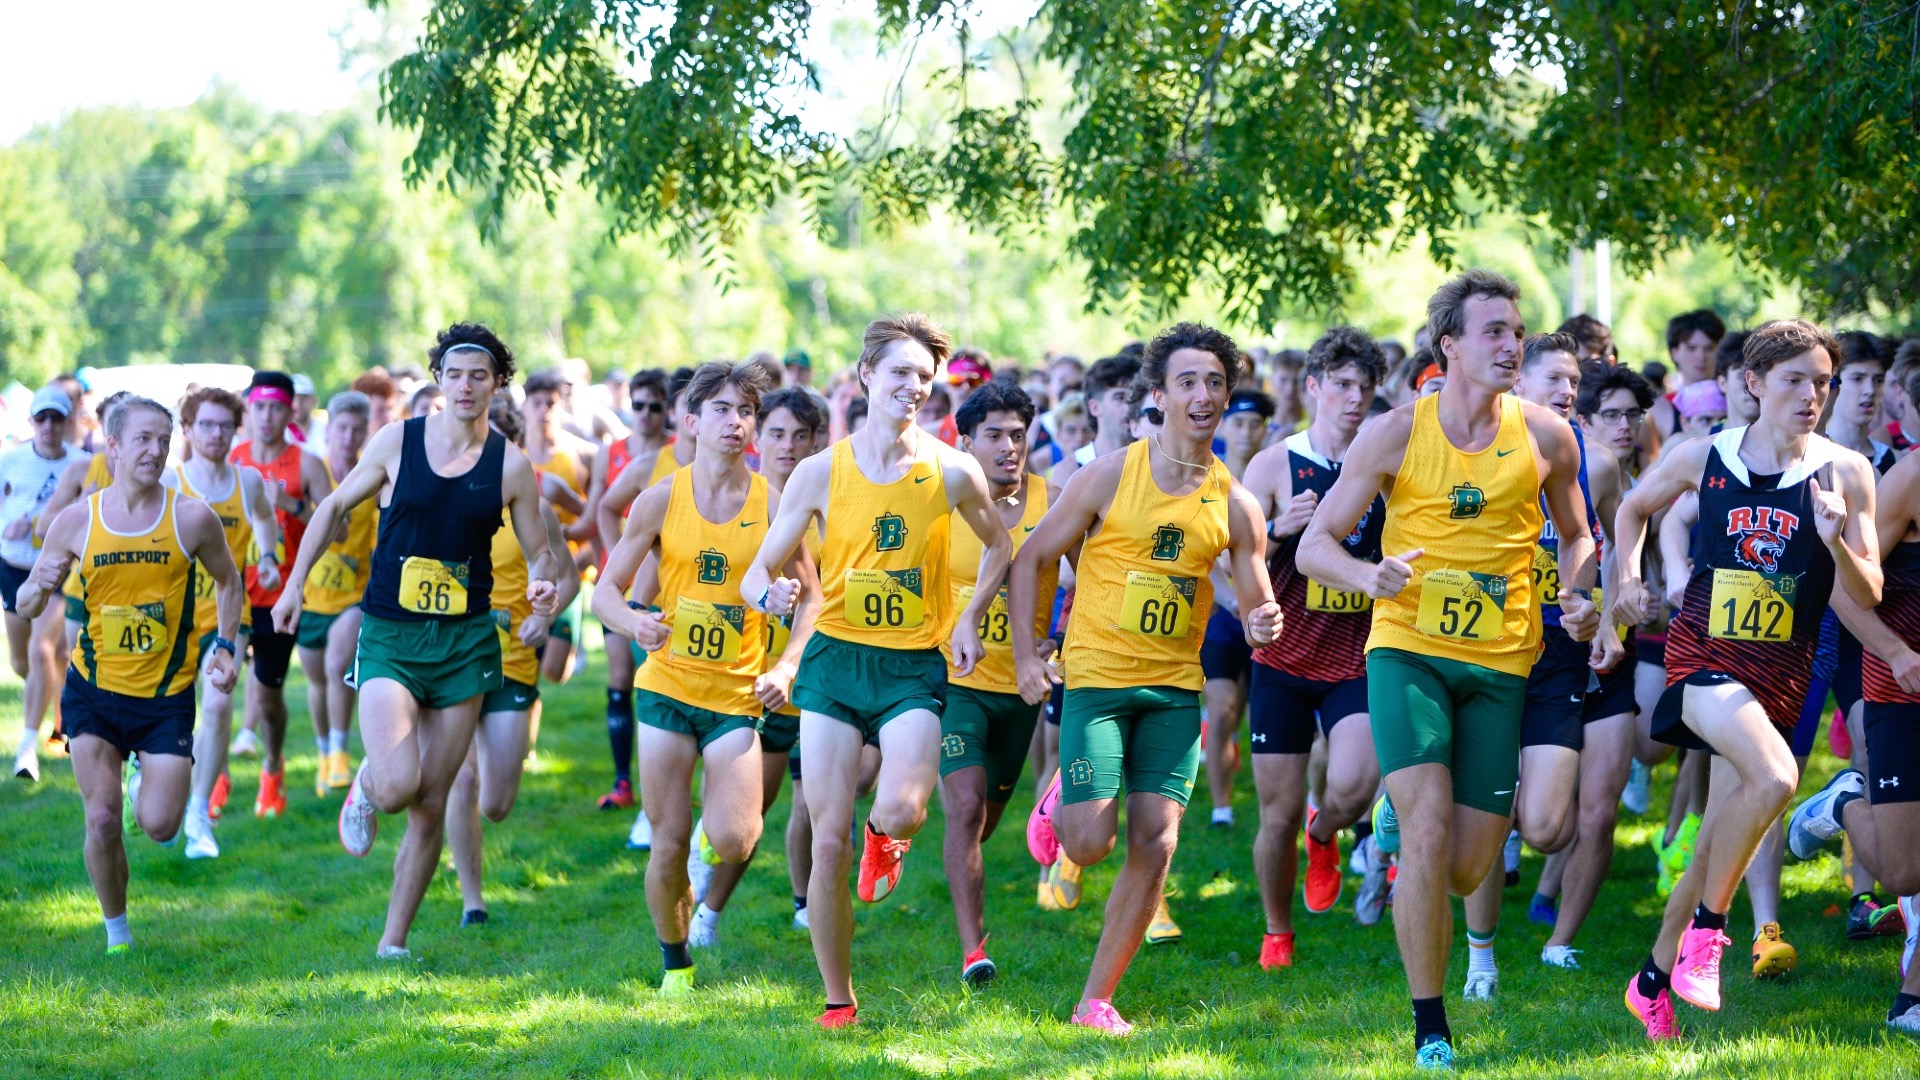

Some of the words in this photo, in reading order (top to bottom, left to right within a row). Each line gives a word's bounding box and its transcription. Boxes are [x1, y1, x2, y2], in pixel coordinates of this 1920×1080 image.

[1449, 483, 1486, 519] B
[874, 513, 907, 552] B
[1727, 506, 1799, 540] RIT
[93, 550, 170, 567] BROCKPORT
[1151, 523, 1184, 562] B
[696, 548, 729, 585] B
[417, 580, 451, 611] 36
[1317, 584, 1364, 610] 130
[1780, 576, 1794, 593] B
[864, 593, 904, 627] 96
[1140, 599, 1179, 635] 60
[1440, 597, 1483, 638] 52
[1722, 598, 1785, 639] 142
[119, 624, 153, 652] 46
[688, 624, 725, 659] 99
[942, 734, 965, 757] B
[1070, 760, 1093, 785] B
